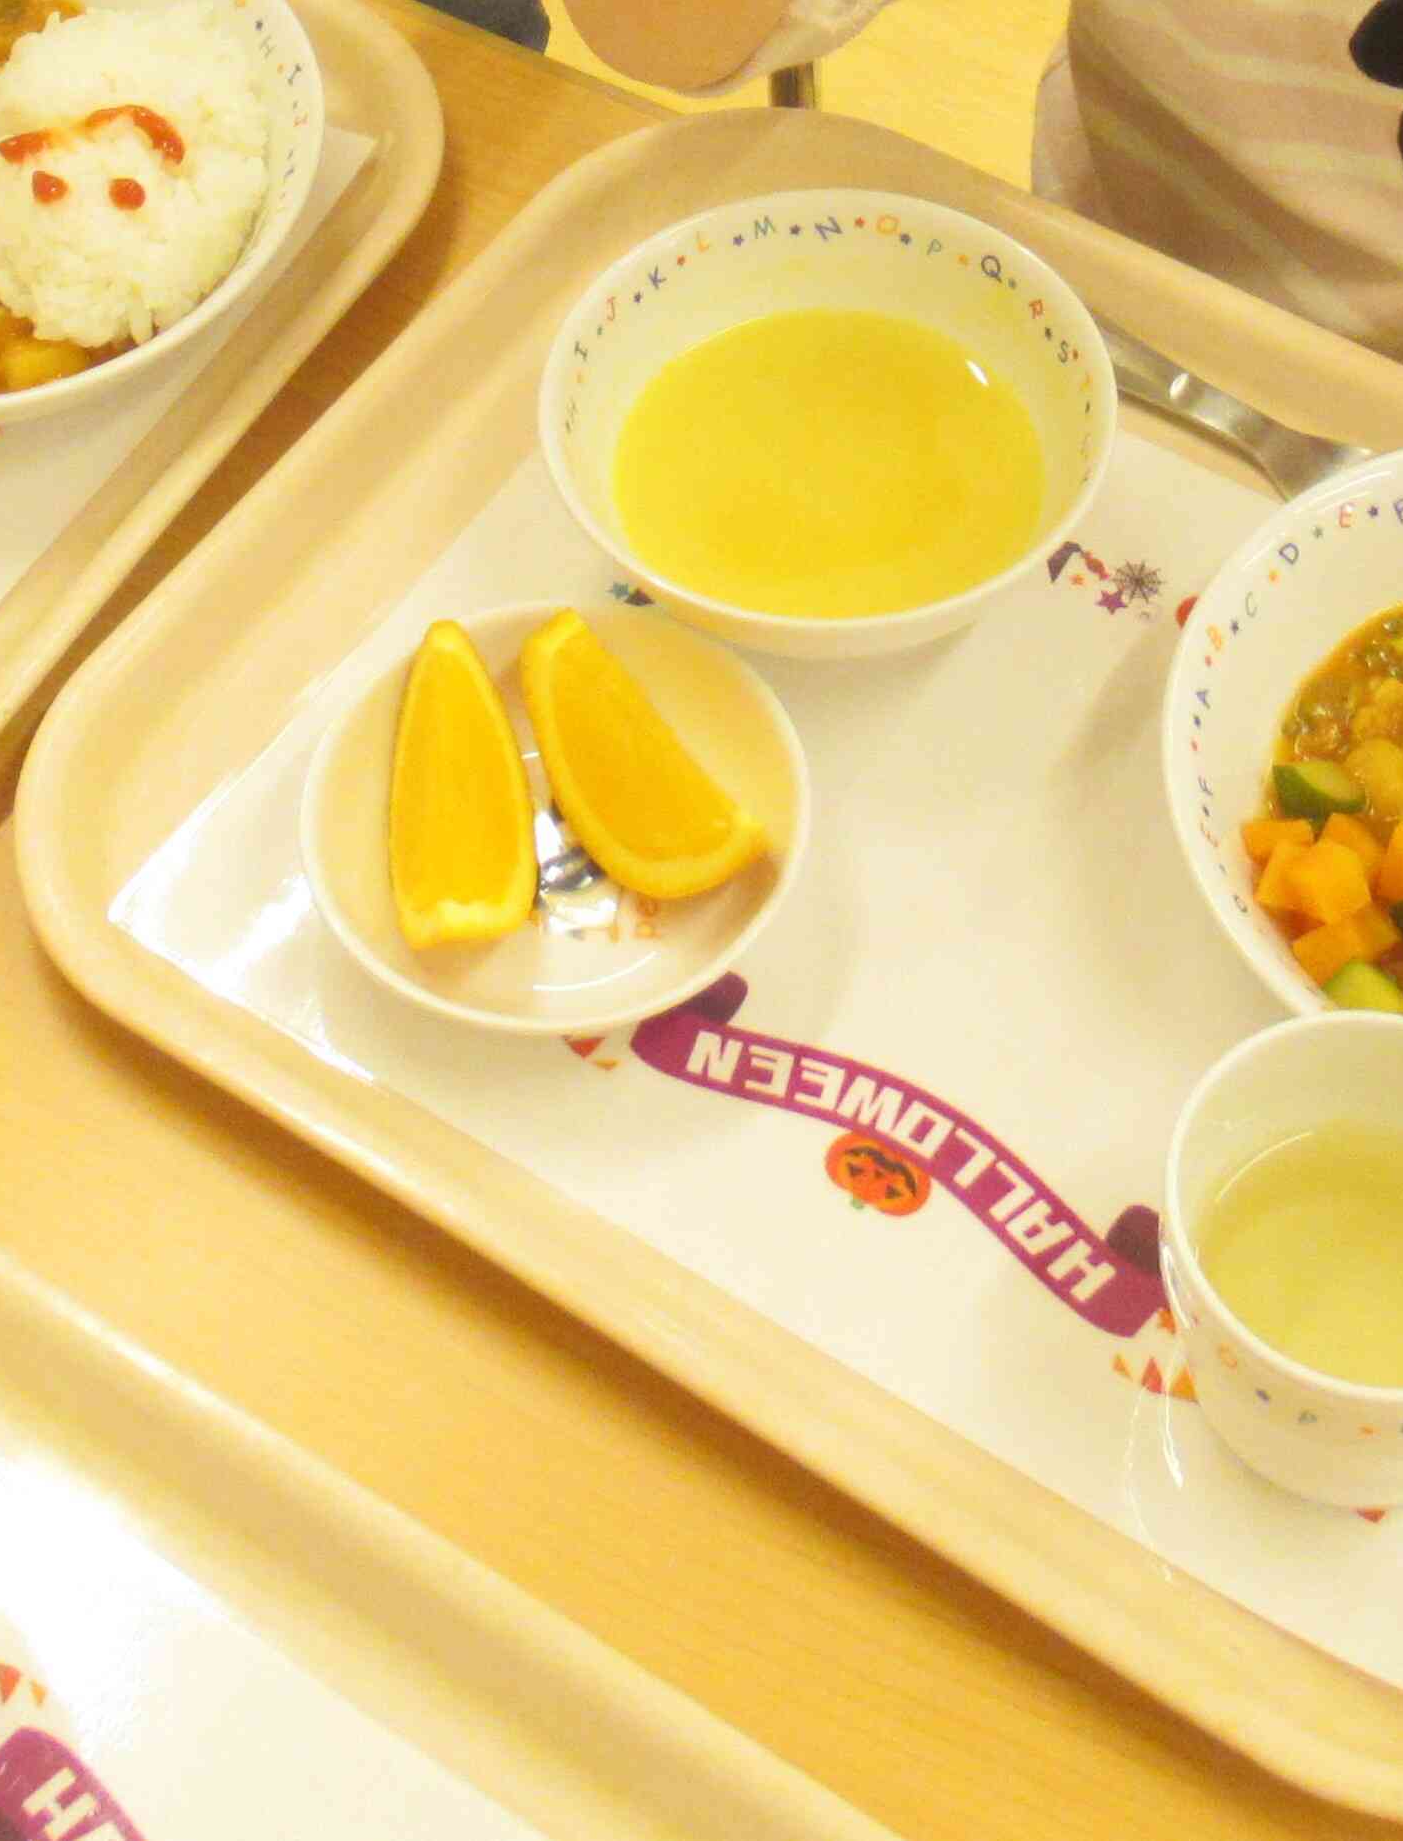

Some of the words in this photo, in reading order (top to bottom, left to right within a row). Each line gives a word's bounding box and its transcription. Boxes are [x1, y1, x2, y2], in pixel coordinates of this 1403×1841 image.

[648, 265, 667, 290] K
[753, 215, 778, 239] M
[814, 216, 843, 242] N
[927, 238, 943, 255] P
[981, 254, 1002, 283] Q
[1278, 542, 1299, 565] D
[1338, 501, 1356, 528] E
[686, 1030, 1117, 1304] HALLOWEEN
